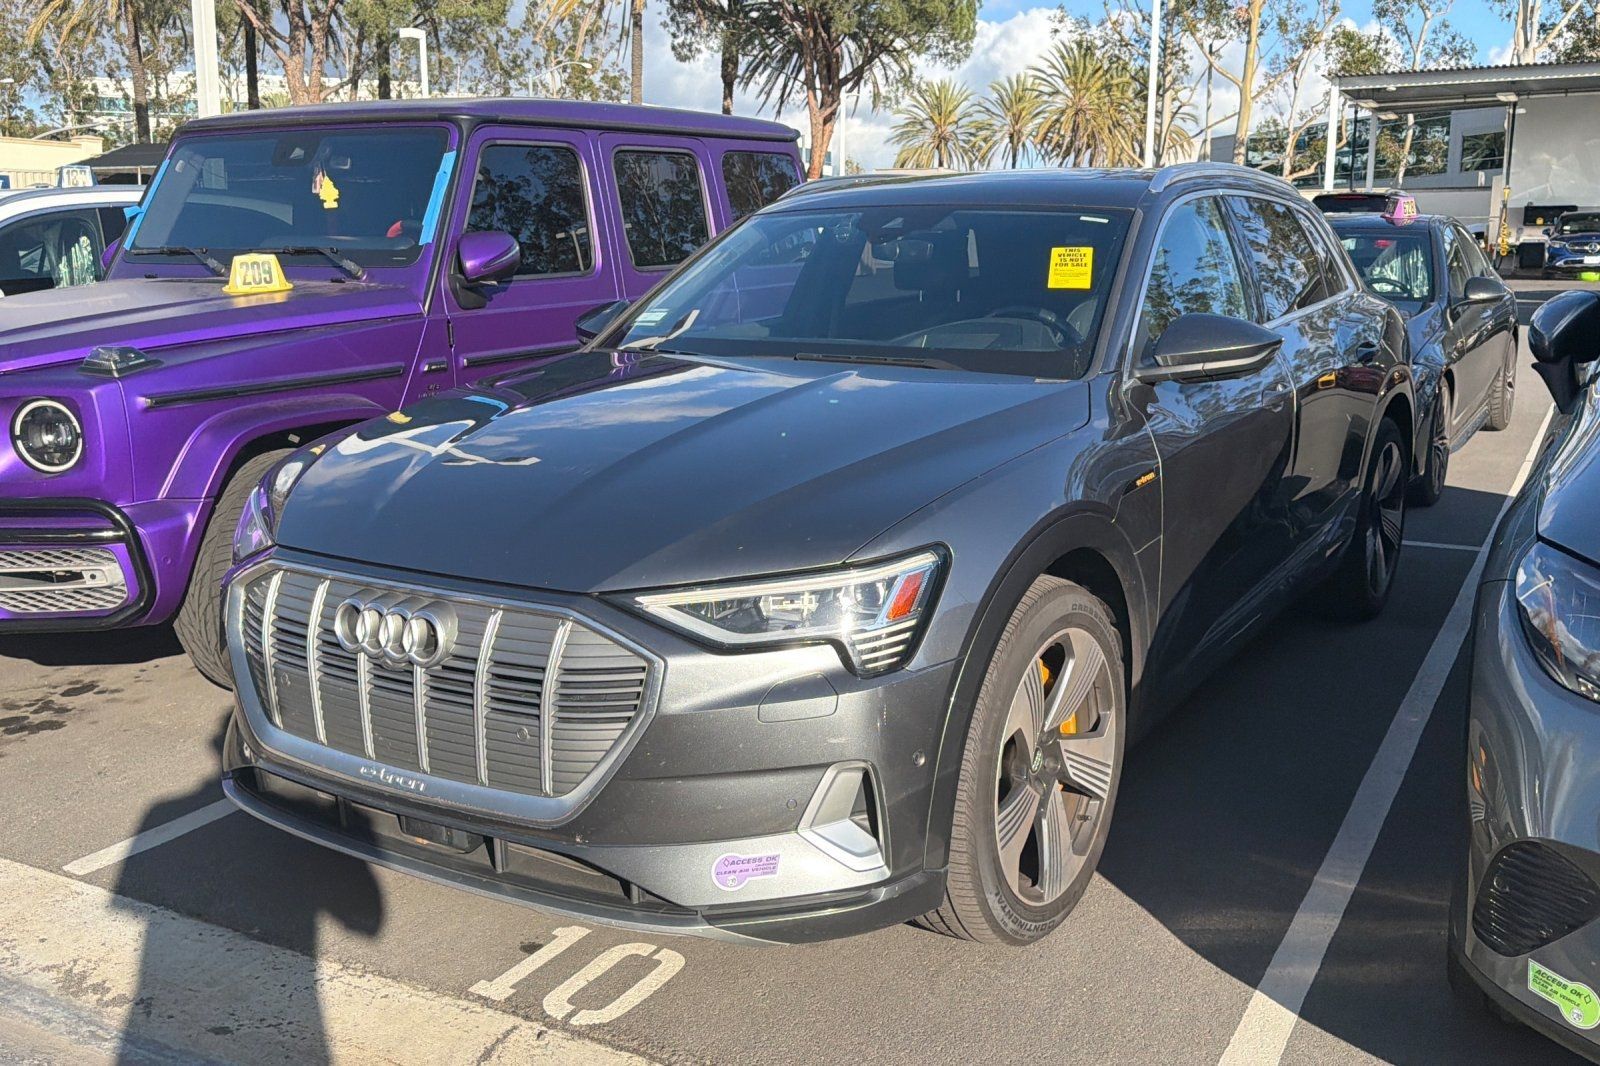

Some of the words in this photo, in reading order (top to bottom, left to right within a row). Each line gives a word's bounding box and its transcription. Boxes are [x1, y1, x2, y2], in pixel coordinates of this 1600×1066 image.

[240, 261, 274, 286] 209
[360, 766, 426, 792] e-tron
[730, 857, 763, 866] ACCESS
[994, 885, 1058, 933] CONTINENTAL
[467, 925, 686, 1026] 10
[1534, 969, 1569, 991] ACCESS
[1569, 988, 1585, 999] OK
[1532, 978, 1549, 990] CLEAN
[1559, 993, 1581, 1007] VEHICLE
